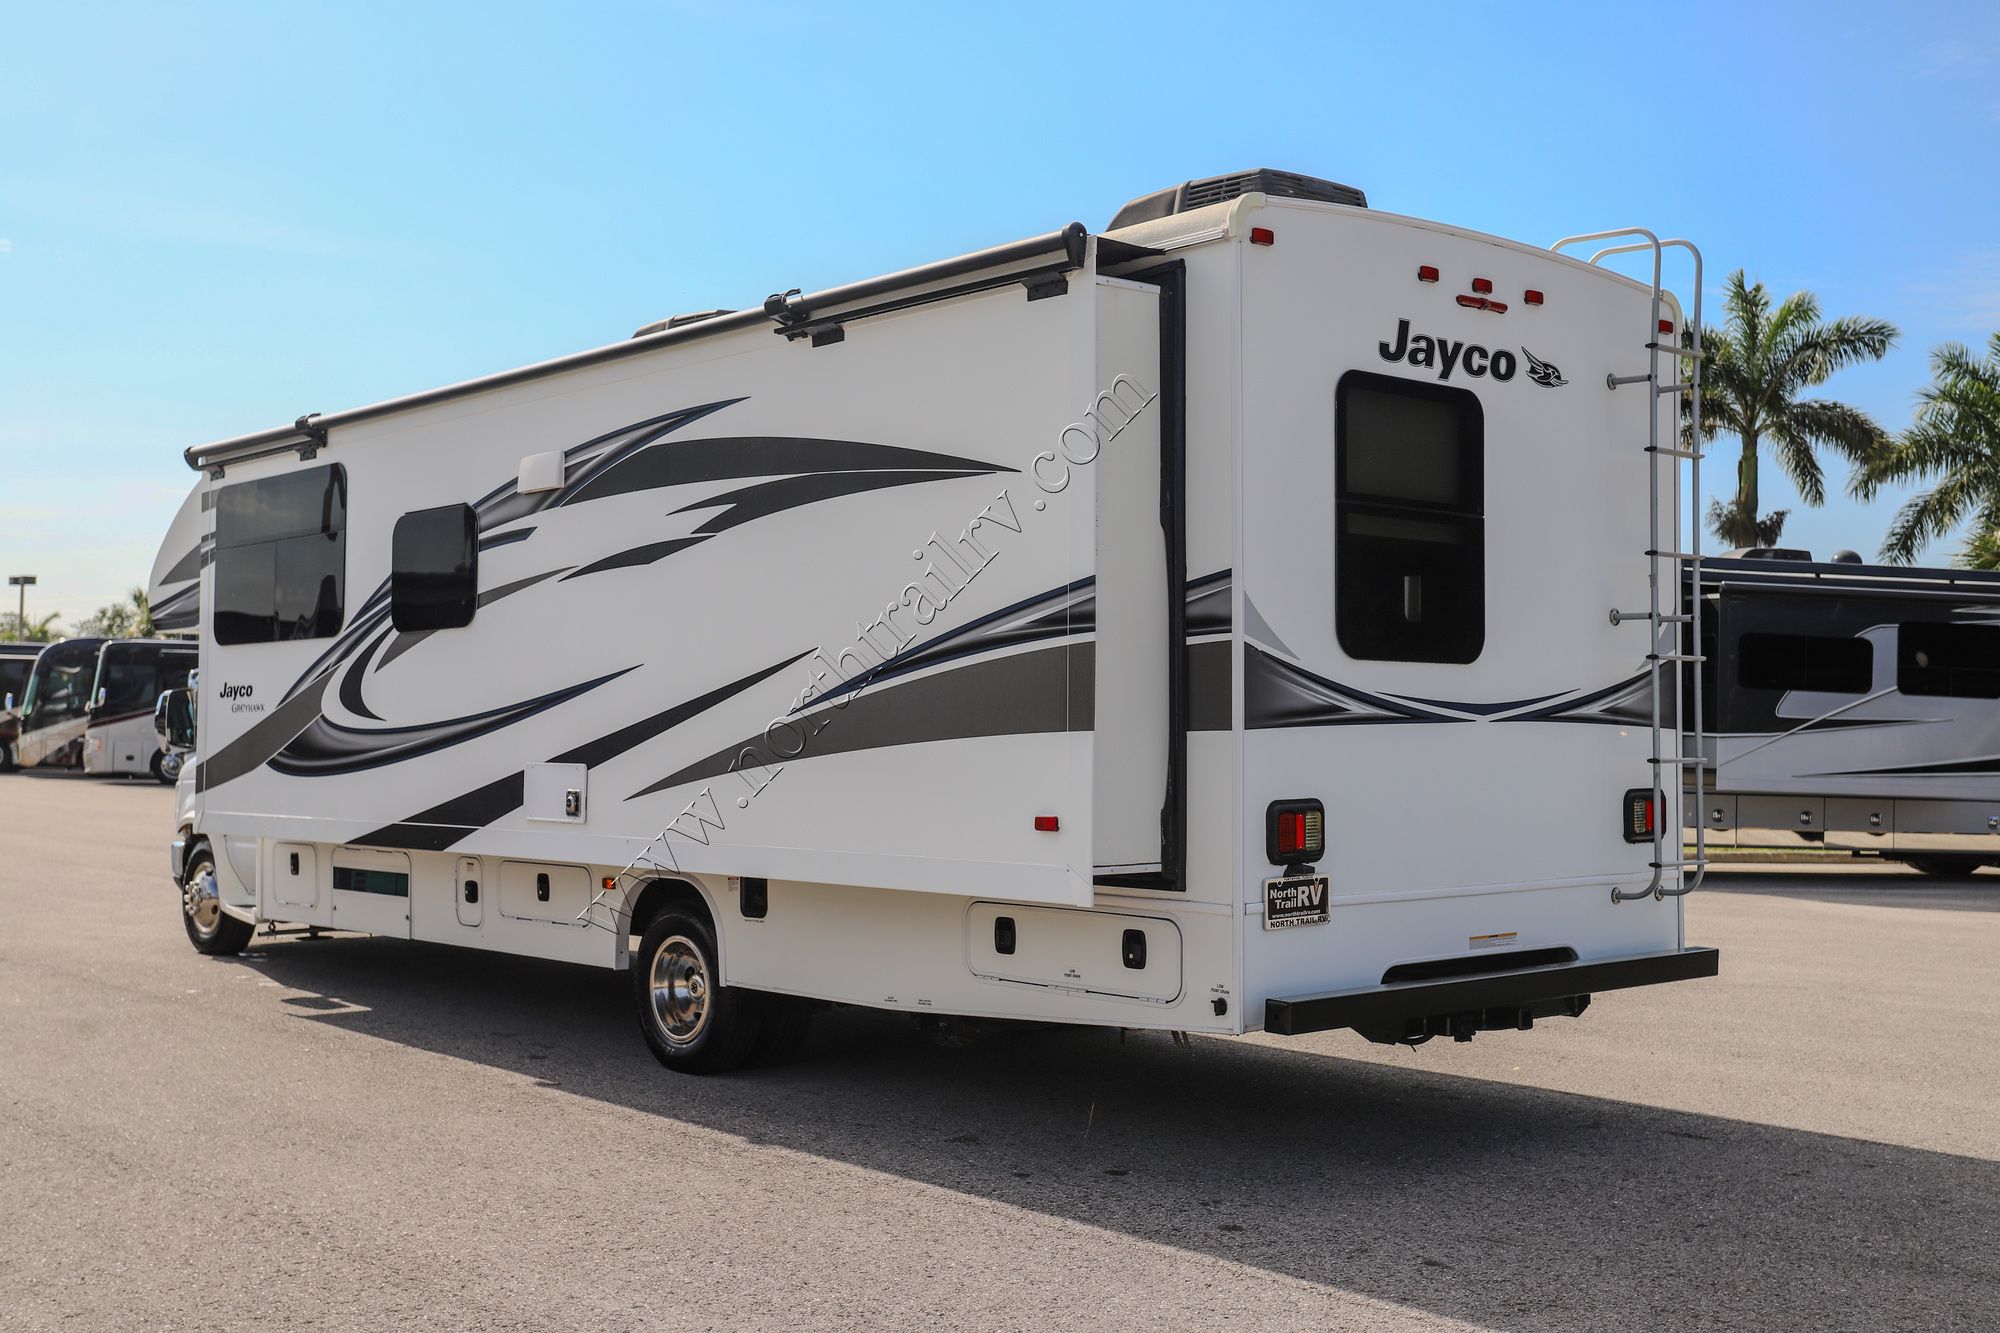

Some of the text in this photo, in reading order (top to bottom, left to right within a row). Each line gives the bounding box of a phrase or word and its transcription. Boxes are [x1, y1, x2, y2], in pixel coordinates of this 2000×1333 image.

[1378, 318, 1516, 382] Jayco
[220, 682, 253, 701] Jayco
[1270, 888, 1297, 899] North
[1275, 885, 1323, 909] Trail RV
[1270, 919, 1295, 929] NORTH
[1296, 916, 1317, 926] TRAIL
